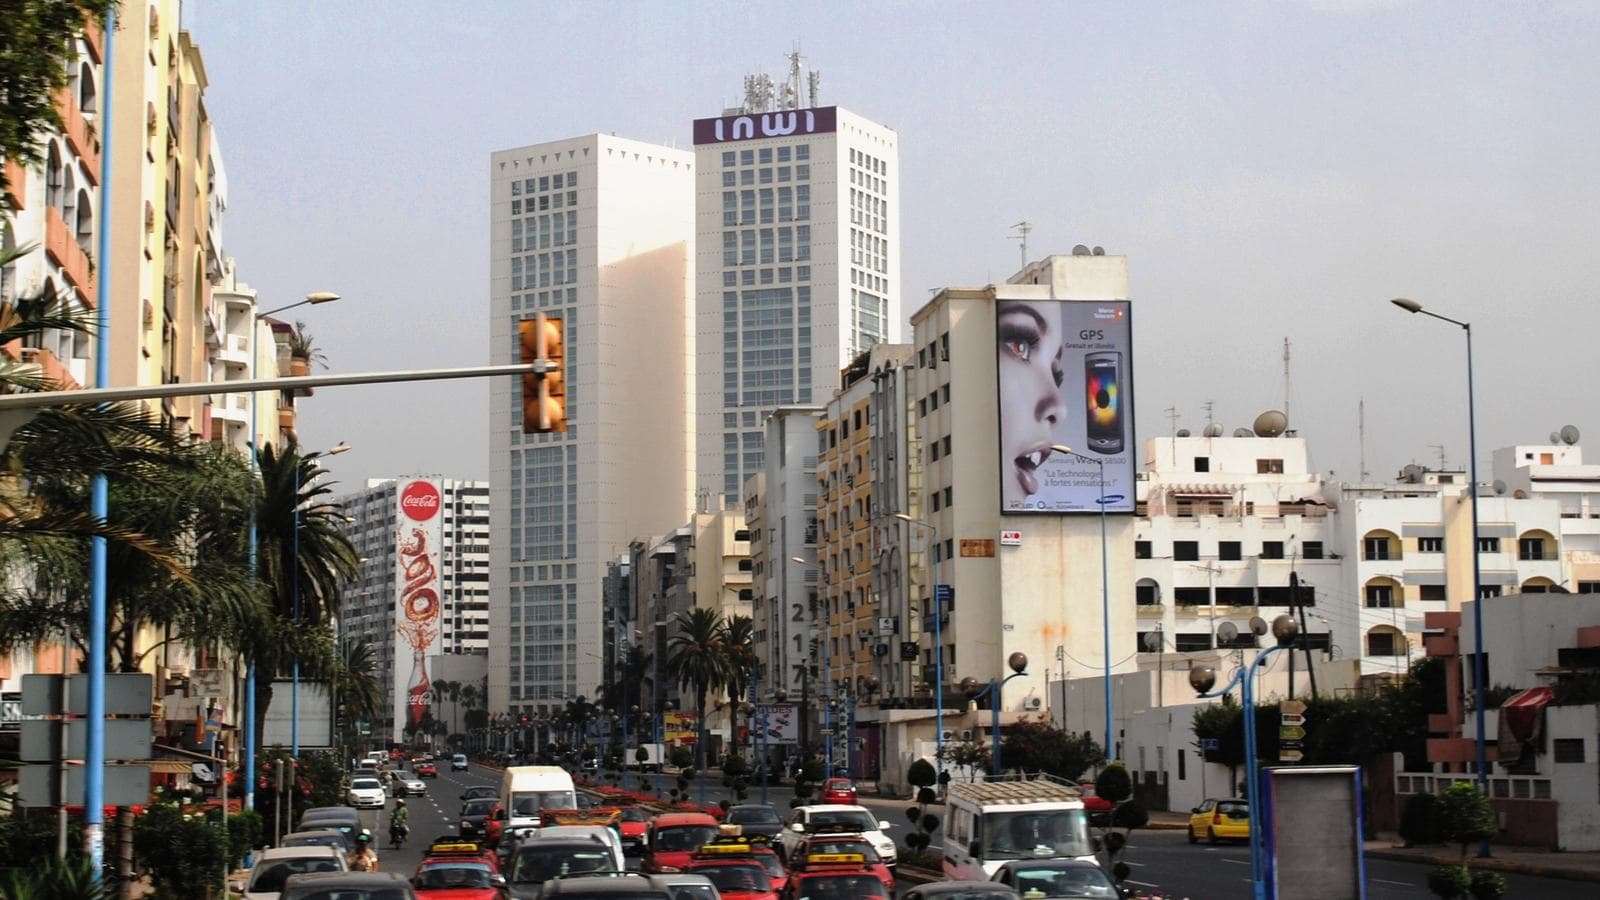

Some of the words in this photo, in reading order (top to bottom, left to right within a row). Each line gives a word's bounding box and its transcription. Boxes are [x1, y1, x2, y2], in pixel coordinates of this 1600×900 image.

[714, 110, 815, 141] inwi
[1079, 329, 1104, 340] GPS
[1075, 455, 1102, 465] Wave
[1056, 469, 1102, 479] Technologie
[1043, 479, 1049, 487] à
[1050, 478, 1071, 487] fortes
[1072, 478, 1111, 487] sensations
[839, 689, 848, 767] PHARMACIE
